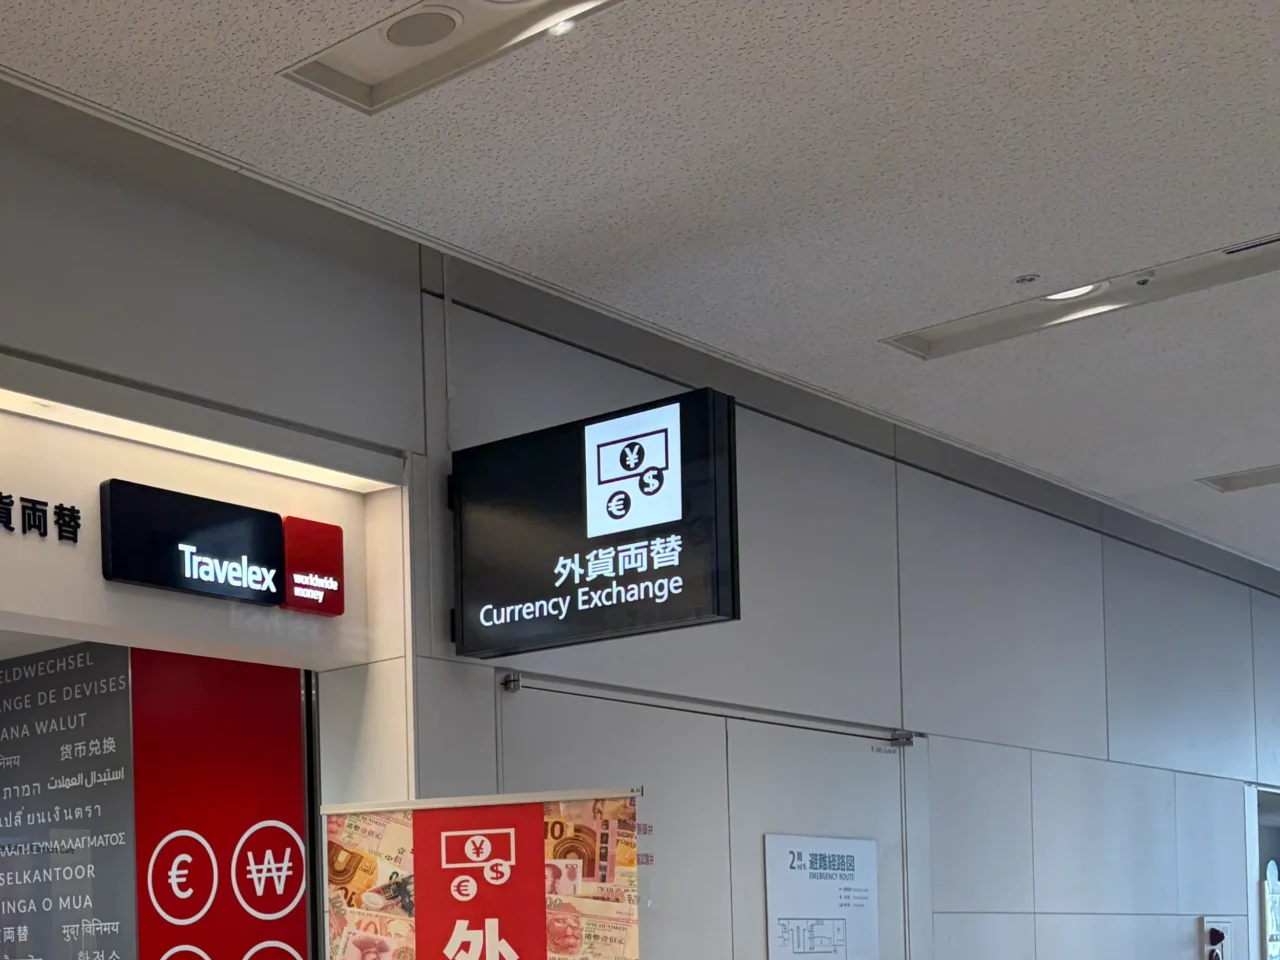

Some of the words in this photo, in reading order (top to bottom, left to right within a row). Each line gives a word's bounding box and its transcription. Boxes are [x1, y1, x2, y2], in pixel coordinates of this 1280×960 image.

[178, 543, 277, 593] Travelex
[554, 535, 682, 587] 外貨両替
[293, 572, 338, 591] worldwide
[293, 586, 324, 603] money
[479, 595, 570, 627] Currency
[577, 575, 683, 610] Exchange
[37, 689, 57, 706] DE
[63, 676, 126, 701] DEVISES
[35, 713, 87, 735] WALUT
[60, 736, 116, 761] 货币兑换
[47, 772, 84, 790] العملات
[85, 766, 125, 788] استبدال
[3, 782, 41, 800] המרת
[788, 850, 797, 870] 2
[809, 852, 855, 872] 避難経路図
[809, 871, 838, 881] EMERGENCY
[839, 873, 855, 881] ROUTE
[42, 898, 53, 911] O
[59, 895, 93, 910] MUA
[81, 918, 120, 937] विनिमय
